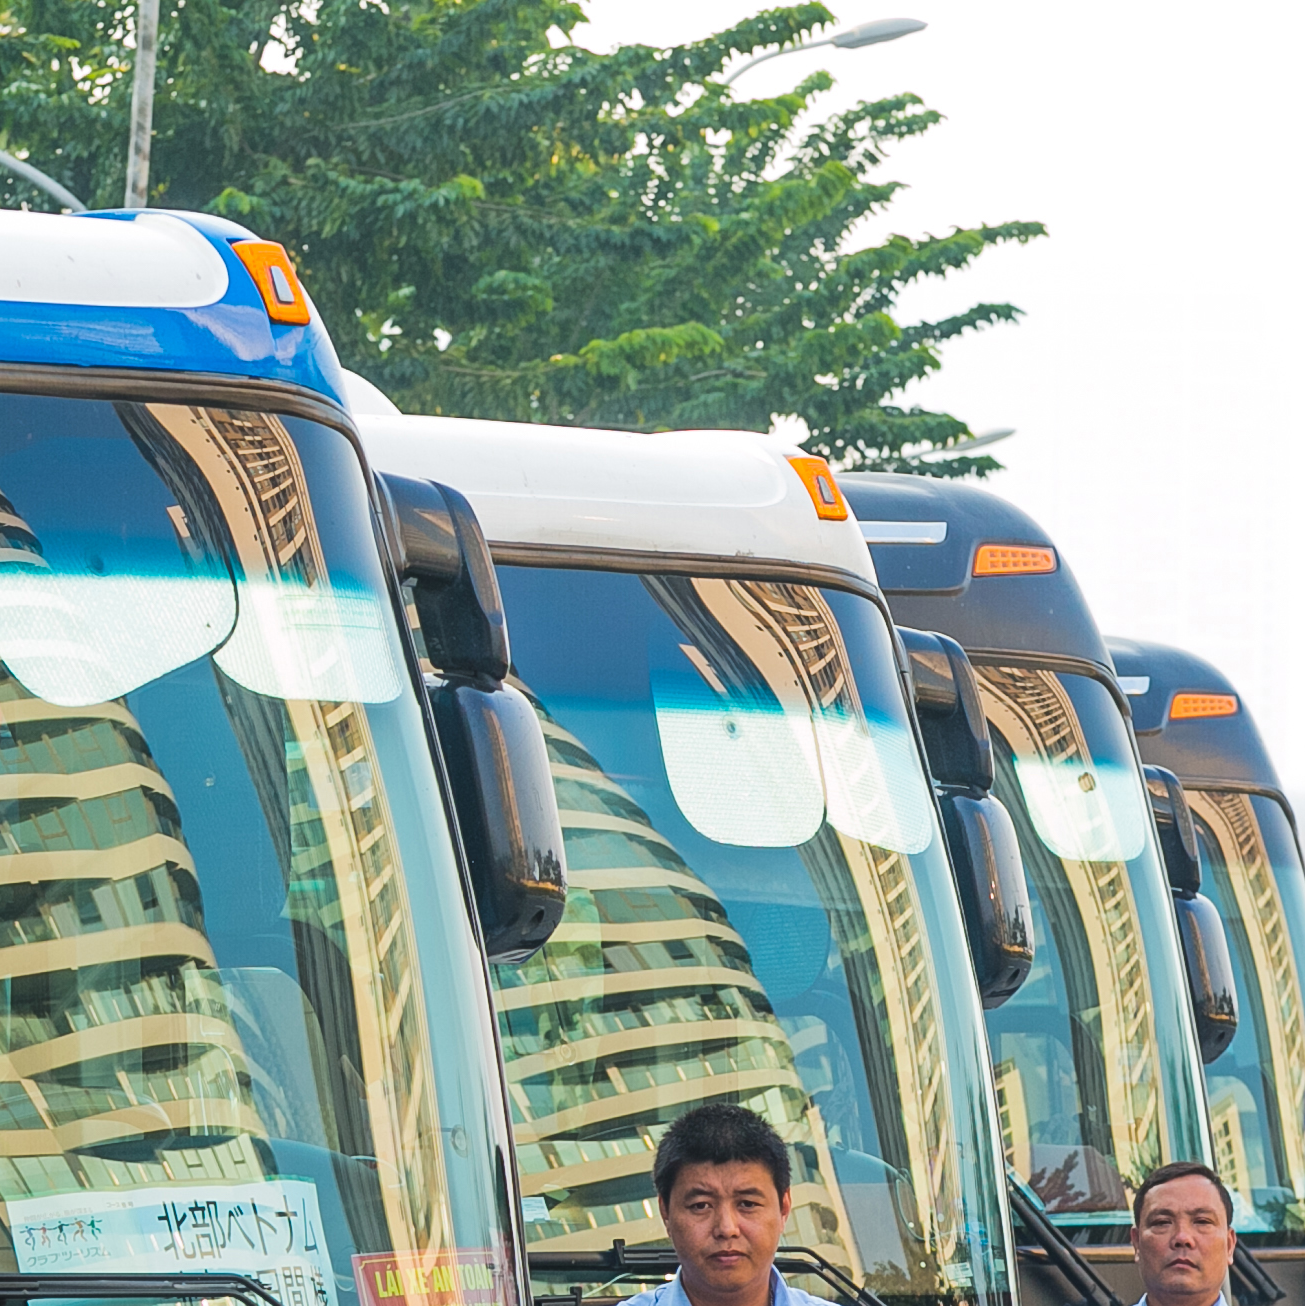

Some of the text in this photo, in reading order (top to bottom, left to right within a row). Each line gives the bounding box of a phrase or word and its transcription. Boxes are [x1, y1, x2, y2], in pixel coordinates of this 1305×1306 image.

[157, 1195, 320, 1260] 北部ベトナム
[27, 1246, 112, 1267] クラブツーリズム
[374, 1258, 494, 1298] LÁI XE AN TOÀN
